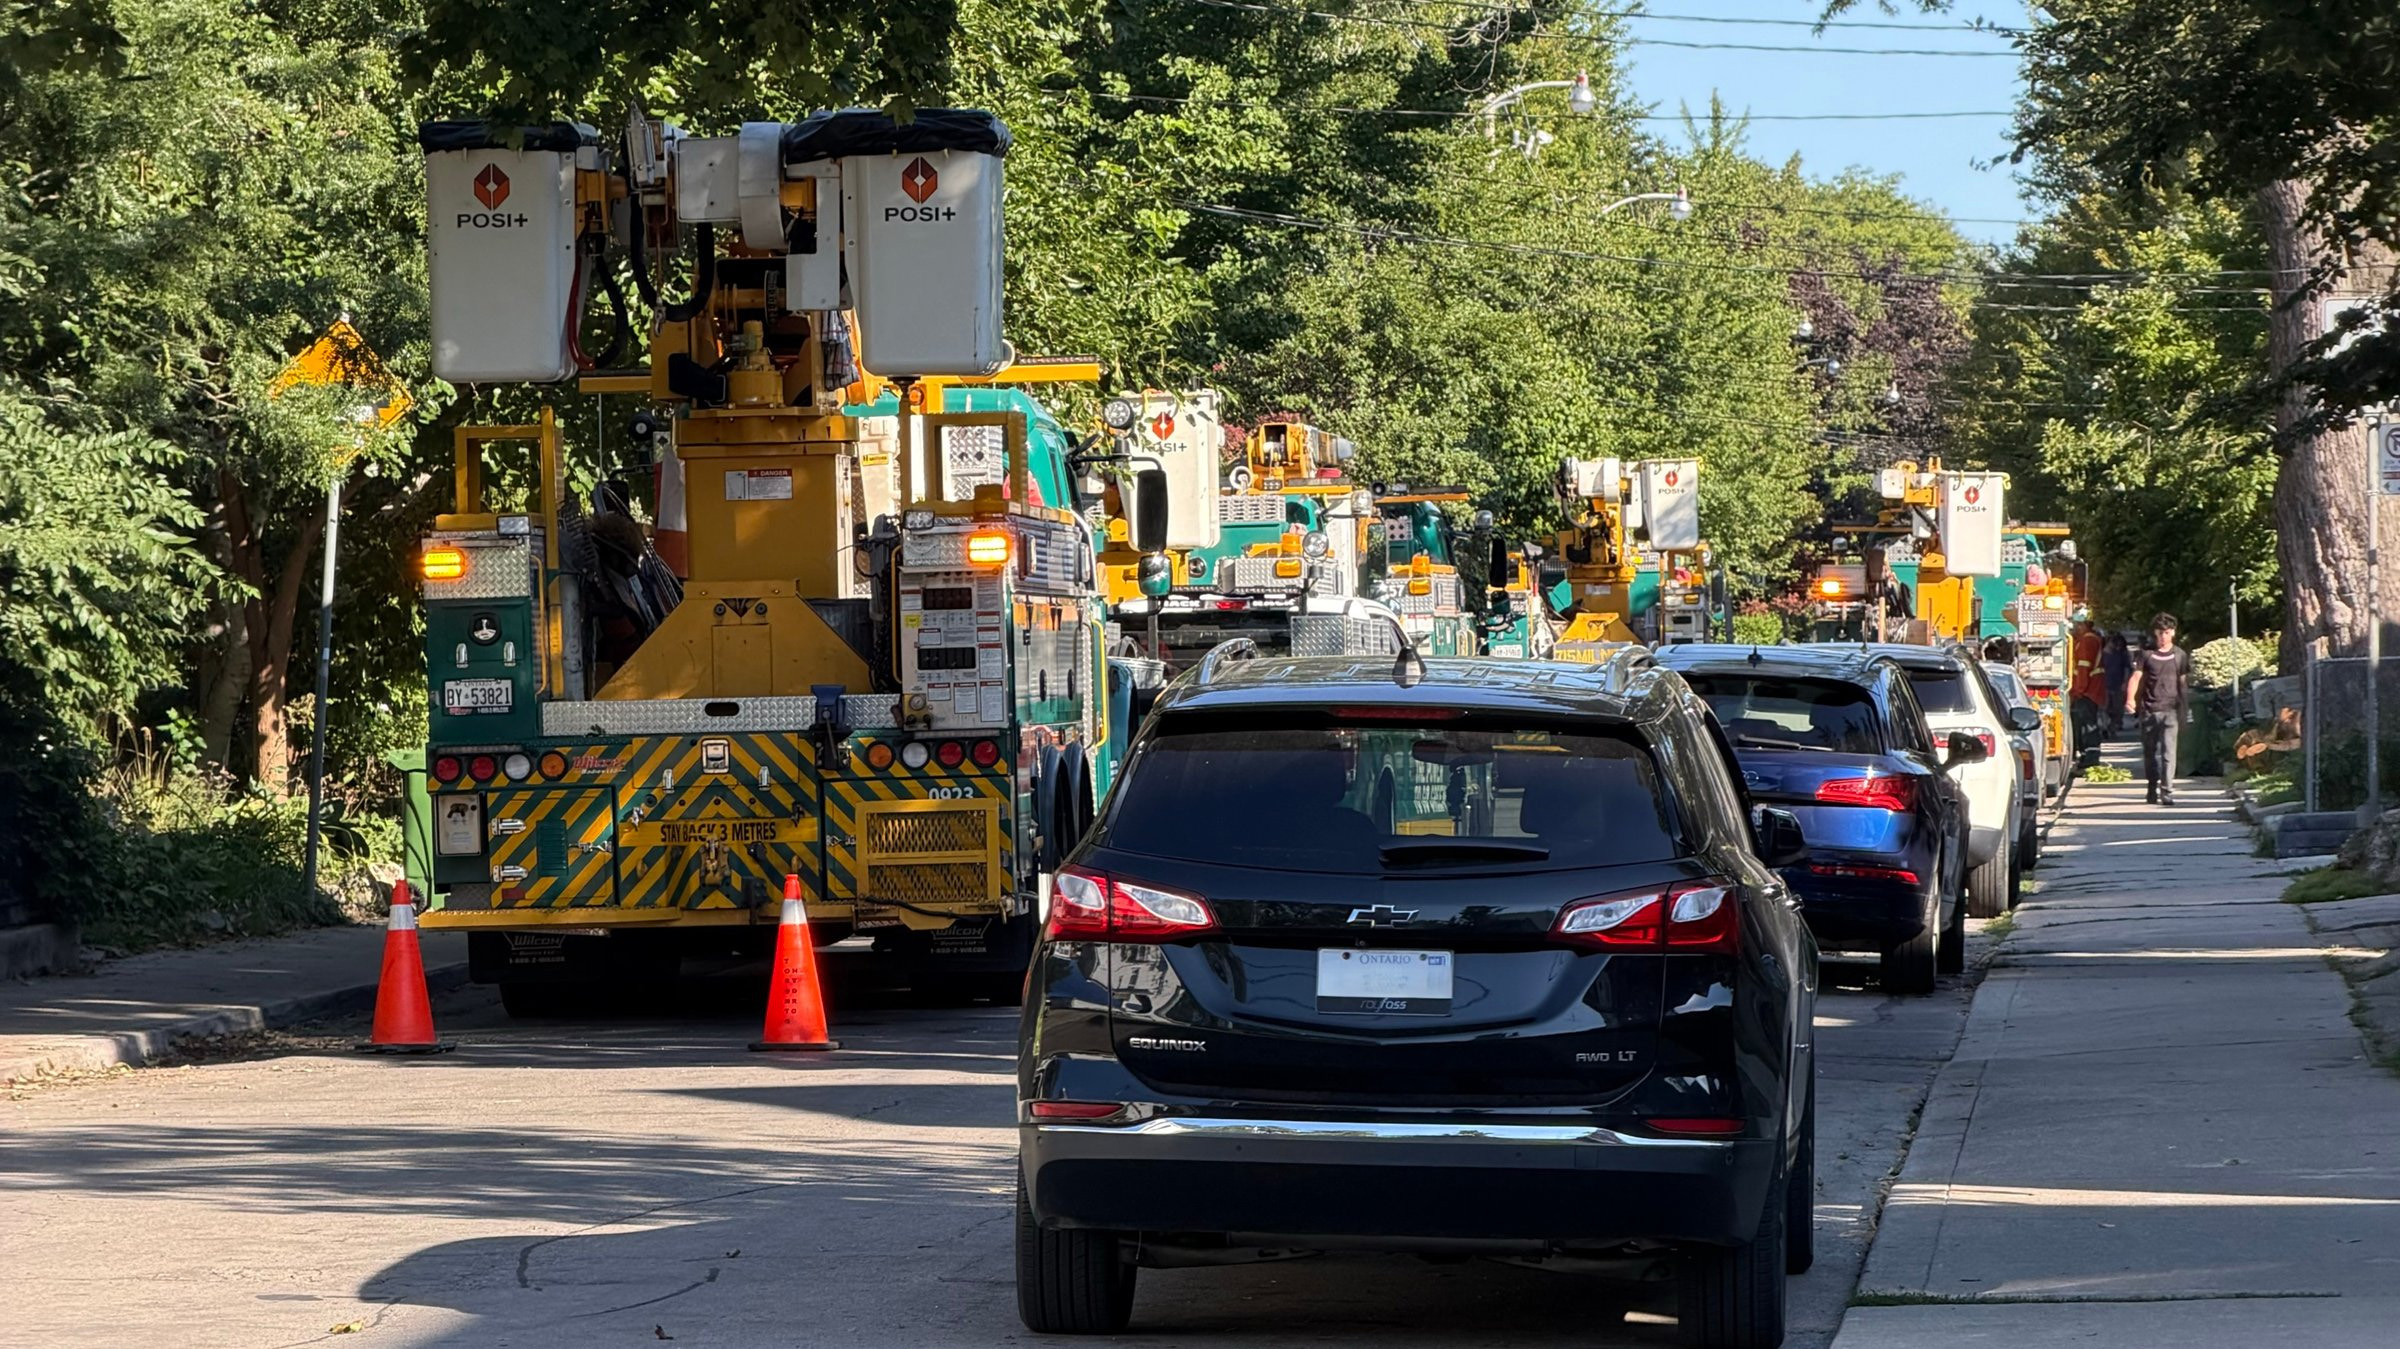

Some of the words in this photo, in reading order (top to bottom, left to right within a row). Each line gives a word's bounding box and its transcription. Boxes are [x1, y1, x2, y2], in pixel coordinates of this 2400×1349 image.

[456, 213, 529, 229] POSI+
[884, 207, 957, 223] POSI+
[1956, 505, 1988, 513] POSI+
[447, 688, 463, 706] BY
[471, 687, 511, 705] 53821
[660, 823, 680, 842] STAY
[682, 822, 717, 842] BACK
[719, 823, 728, 841] 3
[731, 821, 777, 842] METRES
[1359, 953, 1412, 965] ONTARIO
[1129, 1037, 1207, 1052] EQUINOX
[1575, 1052, 1611, 1063] AWD
[1618, 1050, 1638, 1062] LT
